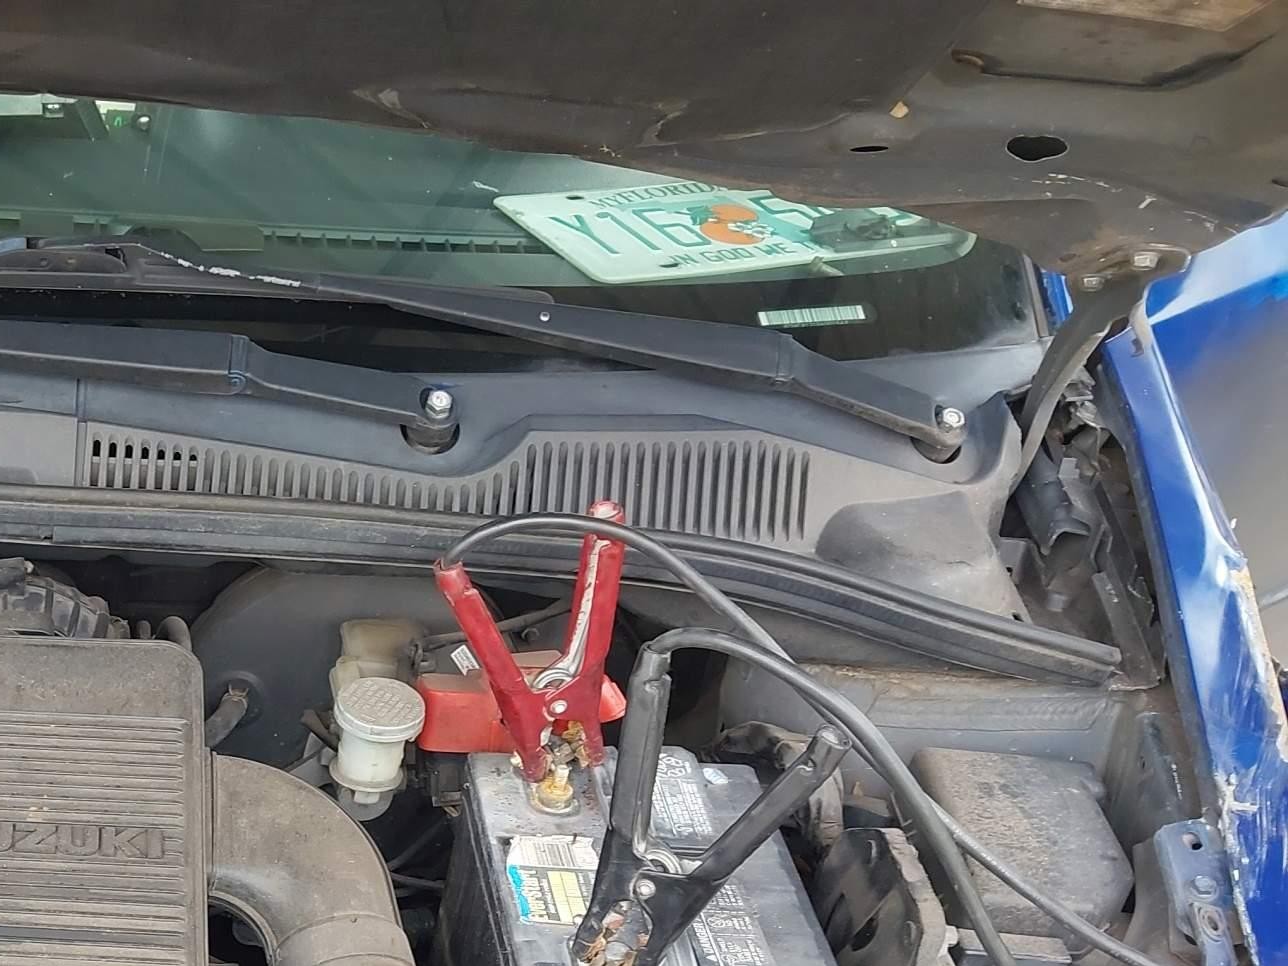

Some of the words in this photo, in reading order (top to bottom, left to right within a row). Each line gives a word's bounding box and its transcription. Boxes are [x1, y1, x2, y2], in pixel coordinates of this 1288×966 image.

[548, 207, 713, 255] Y16
[699, 247, 754, 263] GOD
[754, 241, 794, 257] WE
